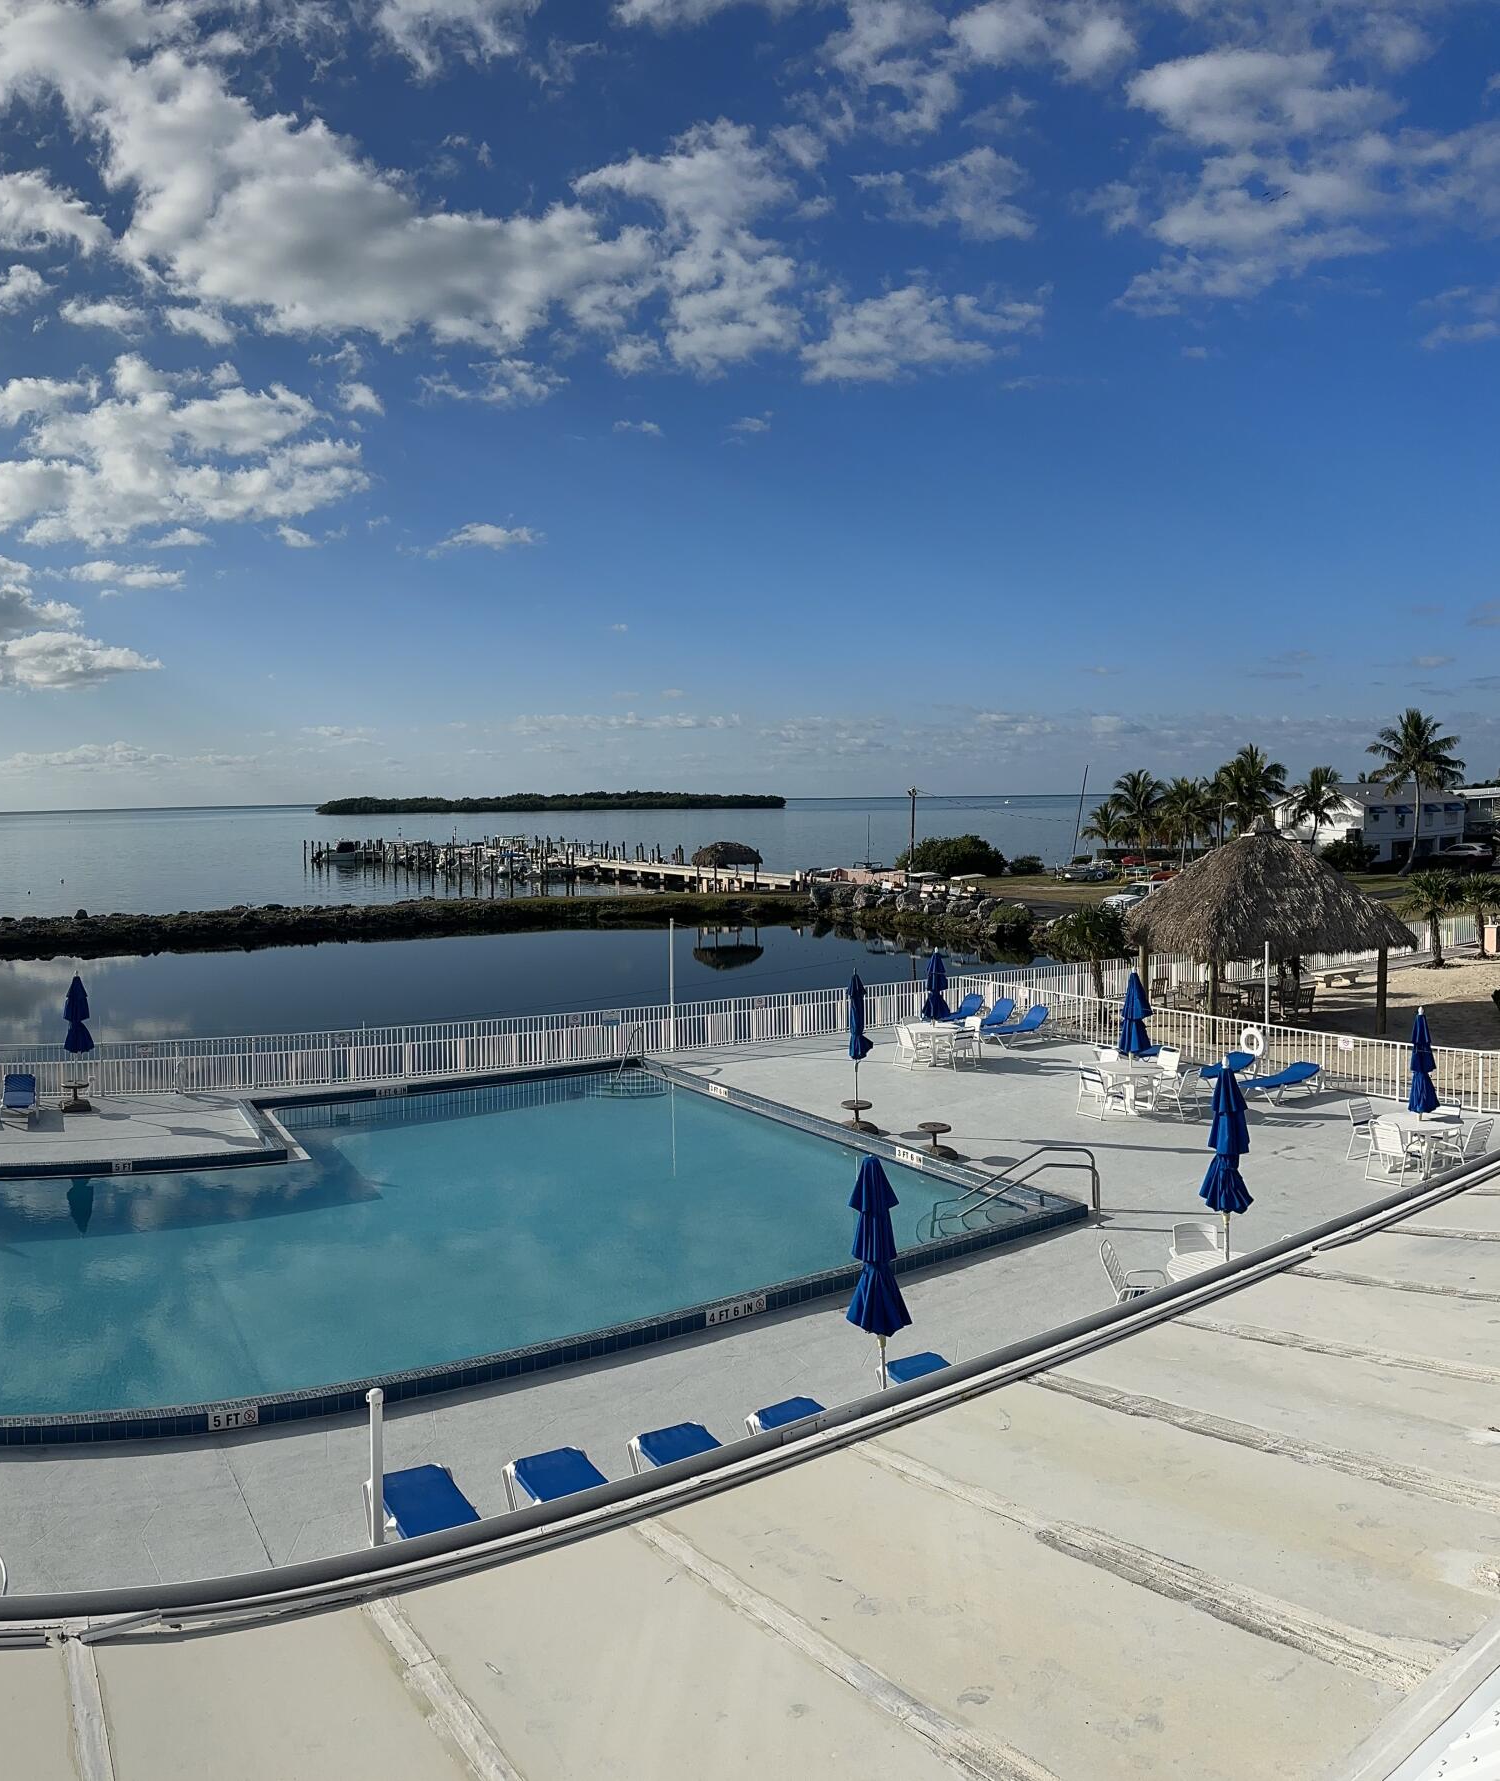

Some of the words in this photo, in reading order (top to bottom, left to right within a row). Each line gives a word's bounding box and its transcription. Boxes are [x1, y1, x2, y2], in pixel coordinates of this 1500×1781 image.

[902, 1151, 909, 1159] FT
[122, 1162, 131, 1171] FT
[709, 1312, 715, 1323] 4
[718, 1308, 730, 1321] FT
[733, 1306, 739, 1317] 6
[743, 1302, 753, 1314] IN
[213, 1415, 221, 1428] 5
[226, 1412, 240, 1426] FT
